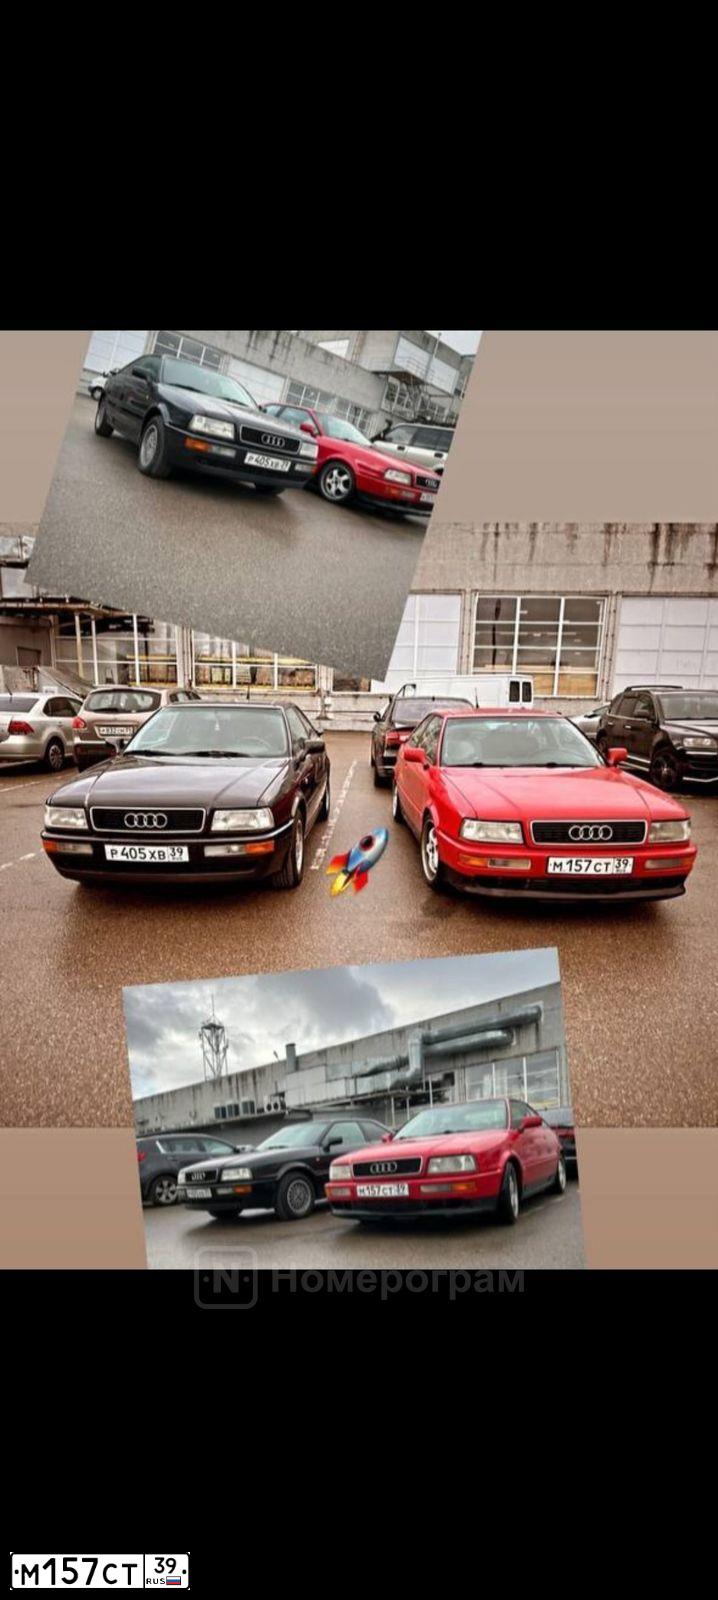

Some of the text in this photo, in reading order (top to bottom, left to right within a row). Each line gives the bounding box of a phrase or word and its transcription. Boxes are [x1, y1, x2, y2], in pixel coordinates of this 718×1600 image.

[110, 847, 183, 860] Р405ХВ 39
[552, 858, 629, 873] М157СТ 39
